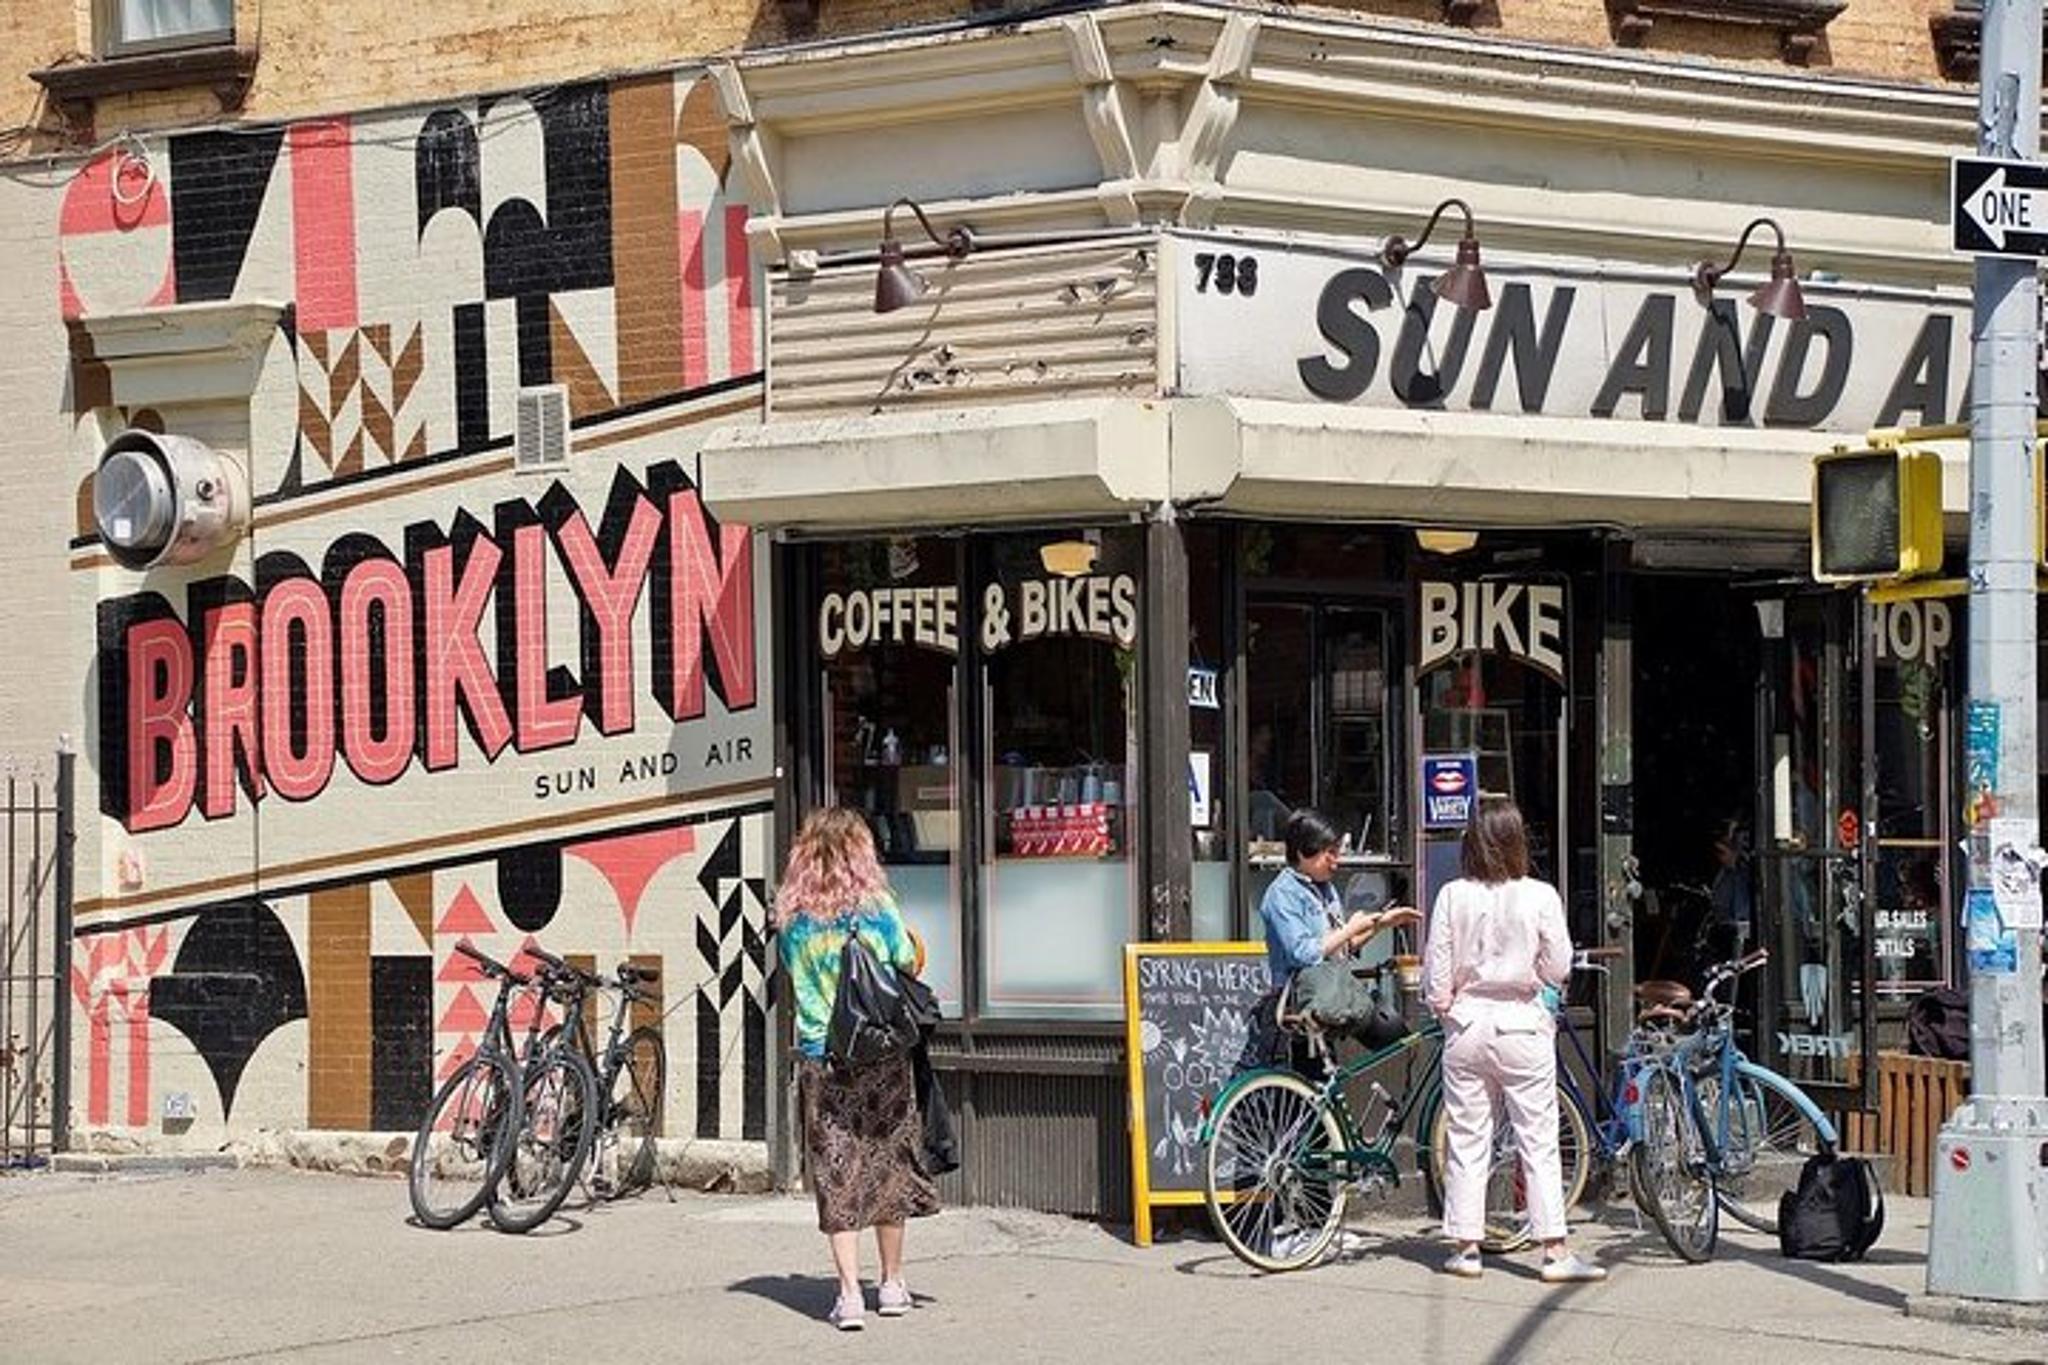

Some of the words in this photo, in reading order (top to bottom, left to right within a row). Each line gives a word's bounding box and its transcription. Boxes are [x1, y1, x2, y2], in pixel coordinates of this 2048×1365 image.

[1983, 190, 2031, 227] ONE
[1296, 267, 1577, 413] SUN
[1590, 293, 1853, 429] AND
[1874, 313, 1973, 427] A
[97, 460, 757, 833] BROOKLYN
[819, 586, 959, 656] COFFEE
[982, 582, 1011, 651] &
[1020, 574, 1137, 645] BIKES
[1420, 581, 1564, 677] BIKE
[535, 768, 596, 799] SUN
[619, 752, 678, 783] AND
[705, 738, 753, 768] AIR
[1140, 958, 1201, 992] SPRING
